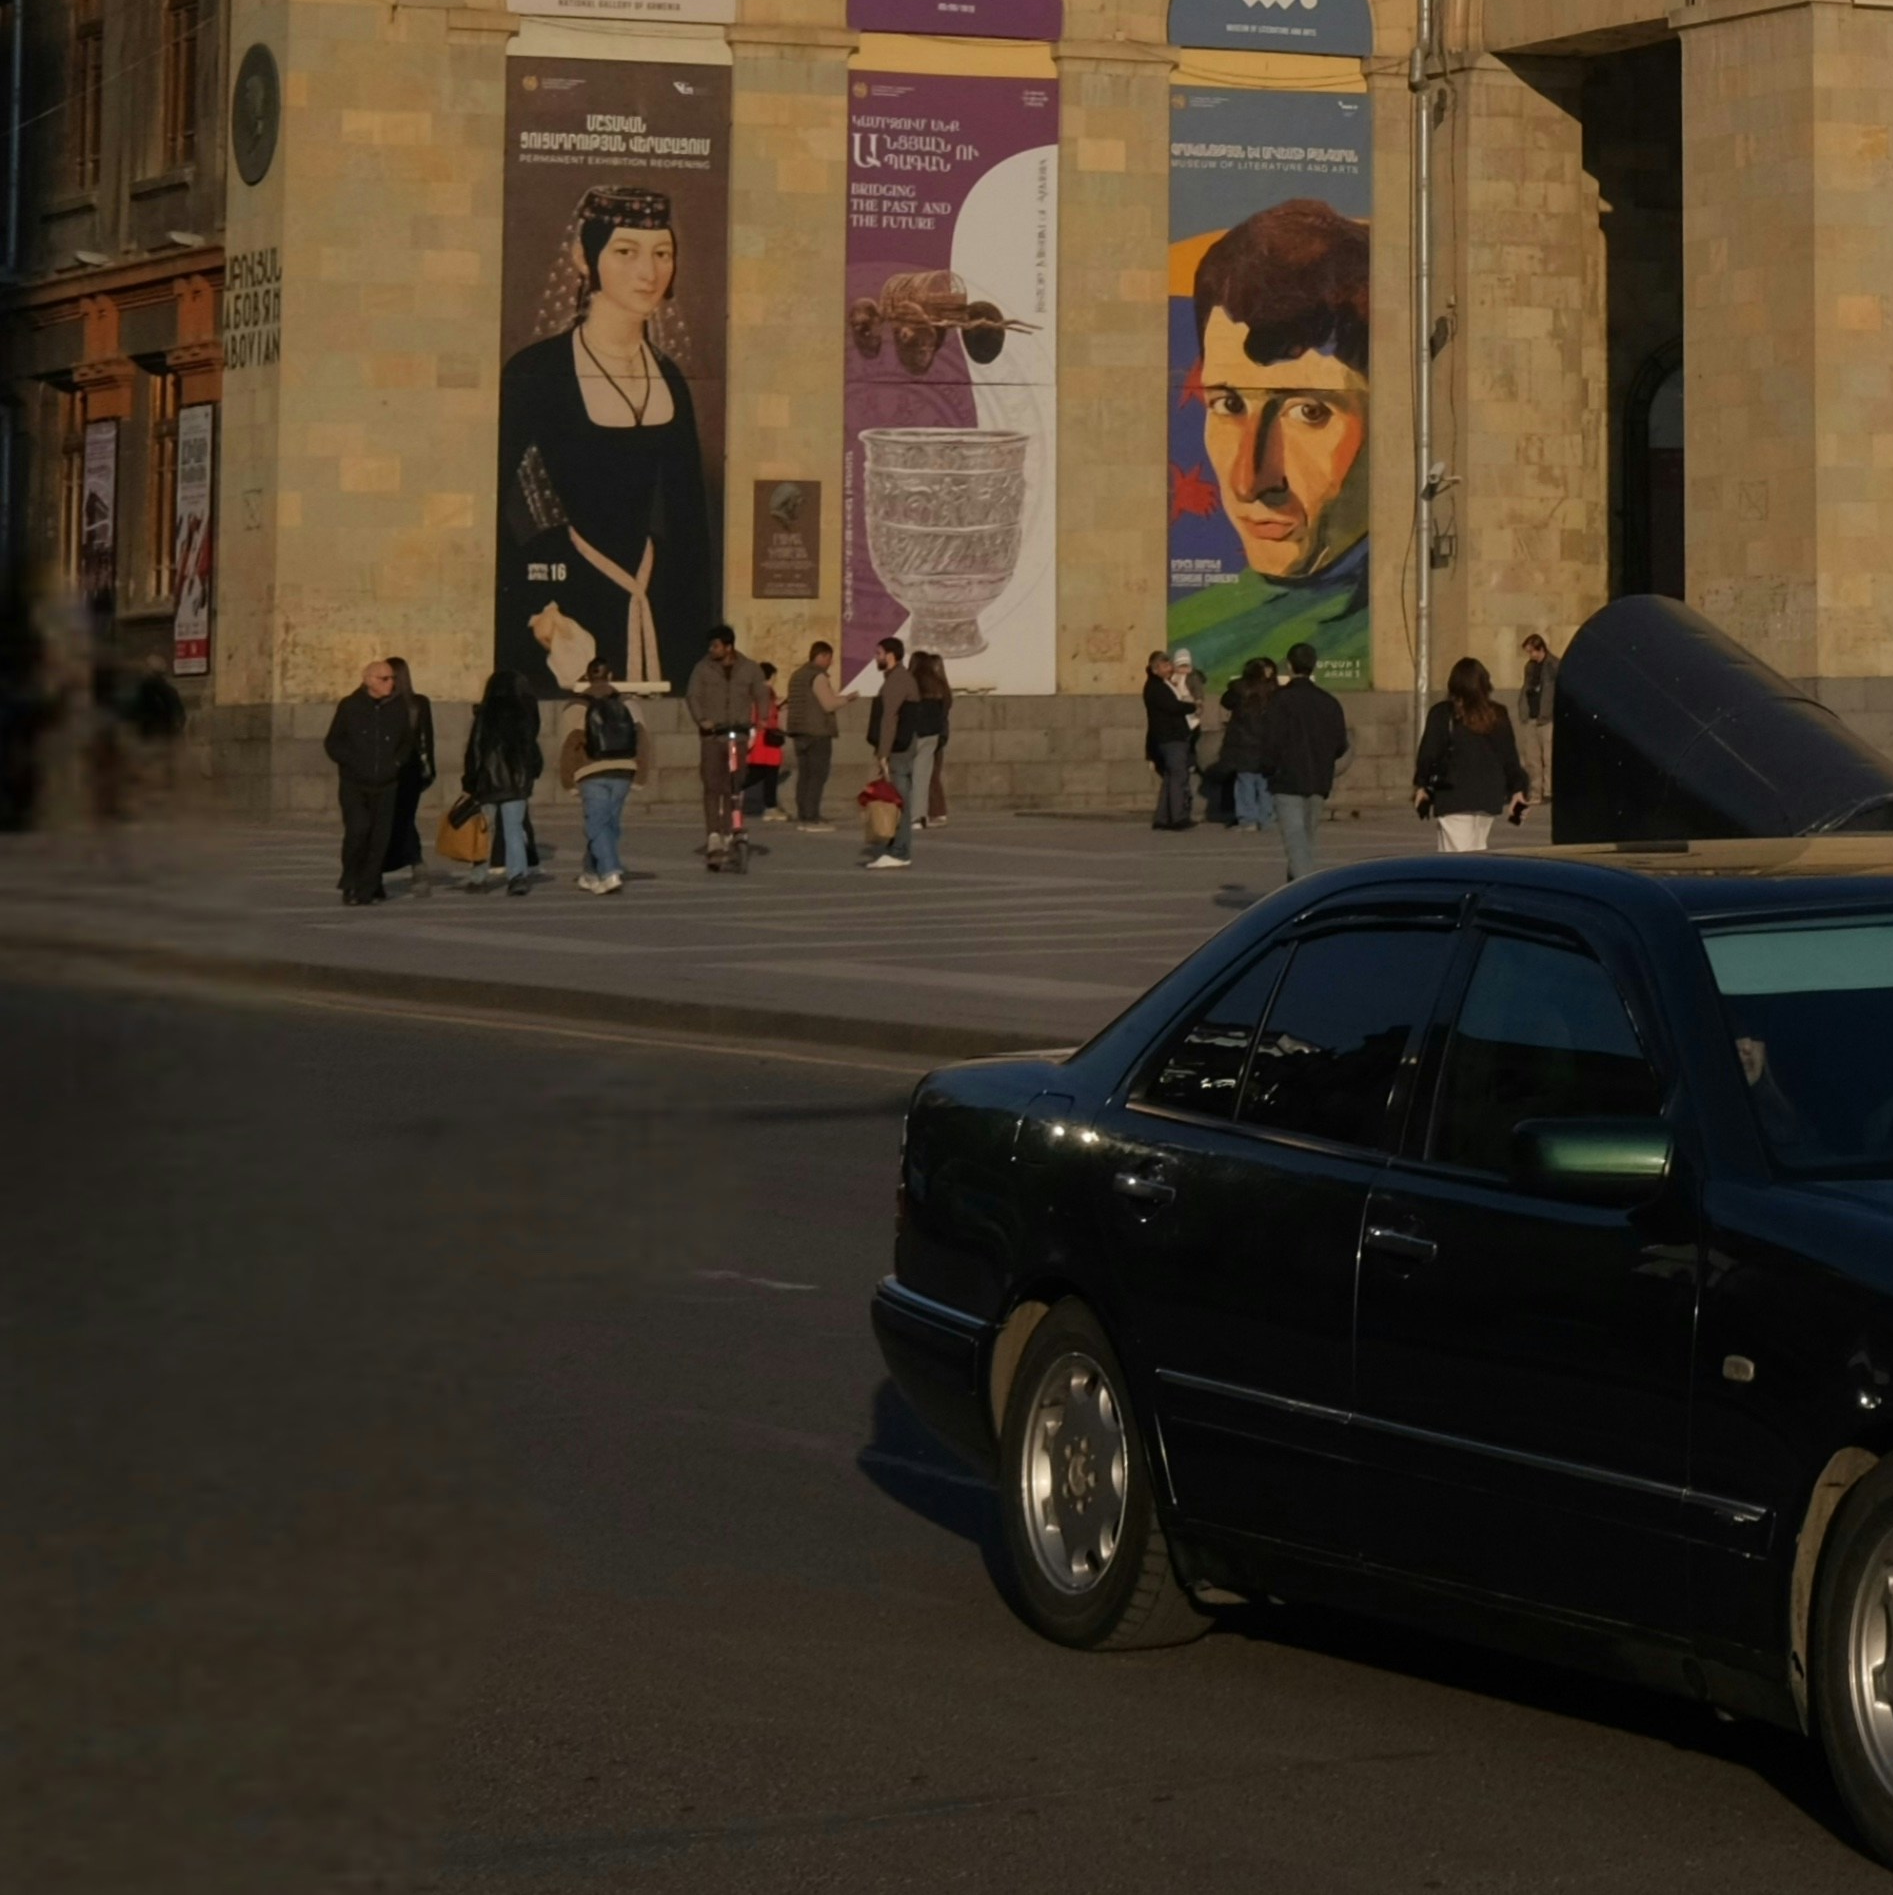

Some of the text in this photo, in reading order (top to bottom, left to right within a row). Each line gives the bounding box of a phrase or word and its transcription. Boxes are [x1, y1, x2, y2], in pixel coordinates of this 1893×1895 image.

[586, 114, 646, 133] ՄՇՏԱԿԱՆ
[519, 153, 711, 169] PERMANENT EXHIBITION REOPENING
[851, 182, 916, 198] BRIDGING
[850, 198, 952, 215] THE PAST AND
[850, 214, 936, 230] THE FUTURE
[550, 563, 567, 581] 16
